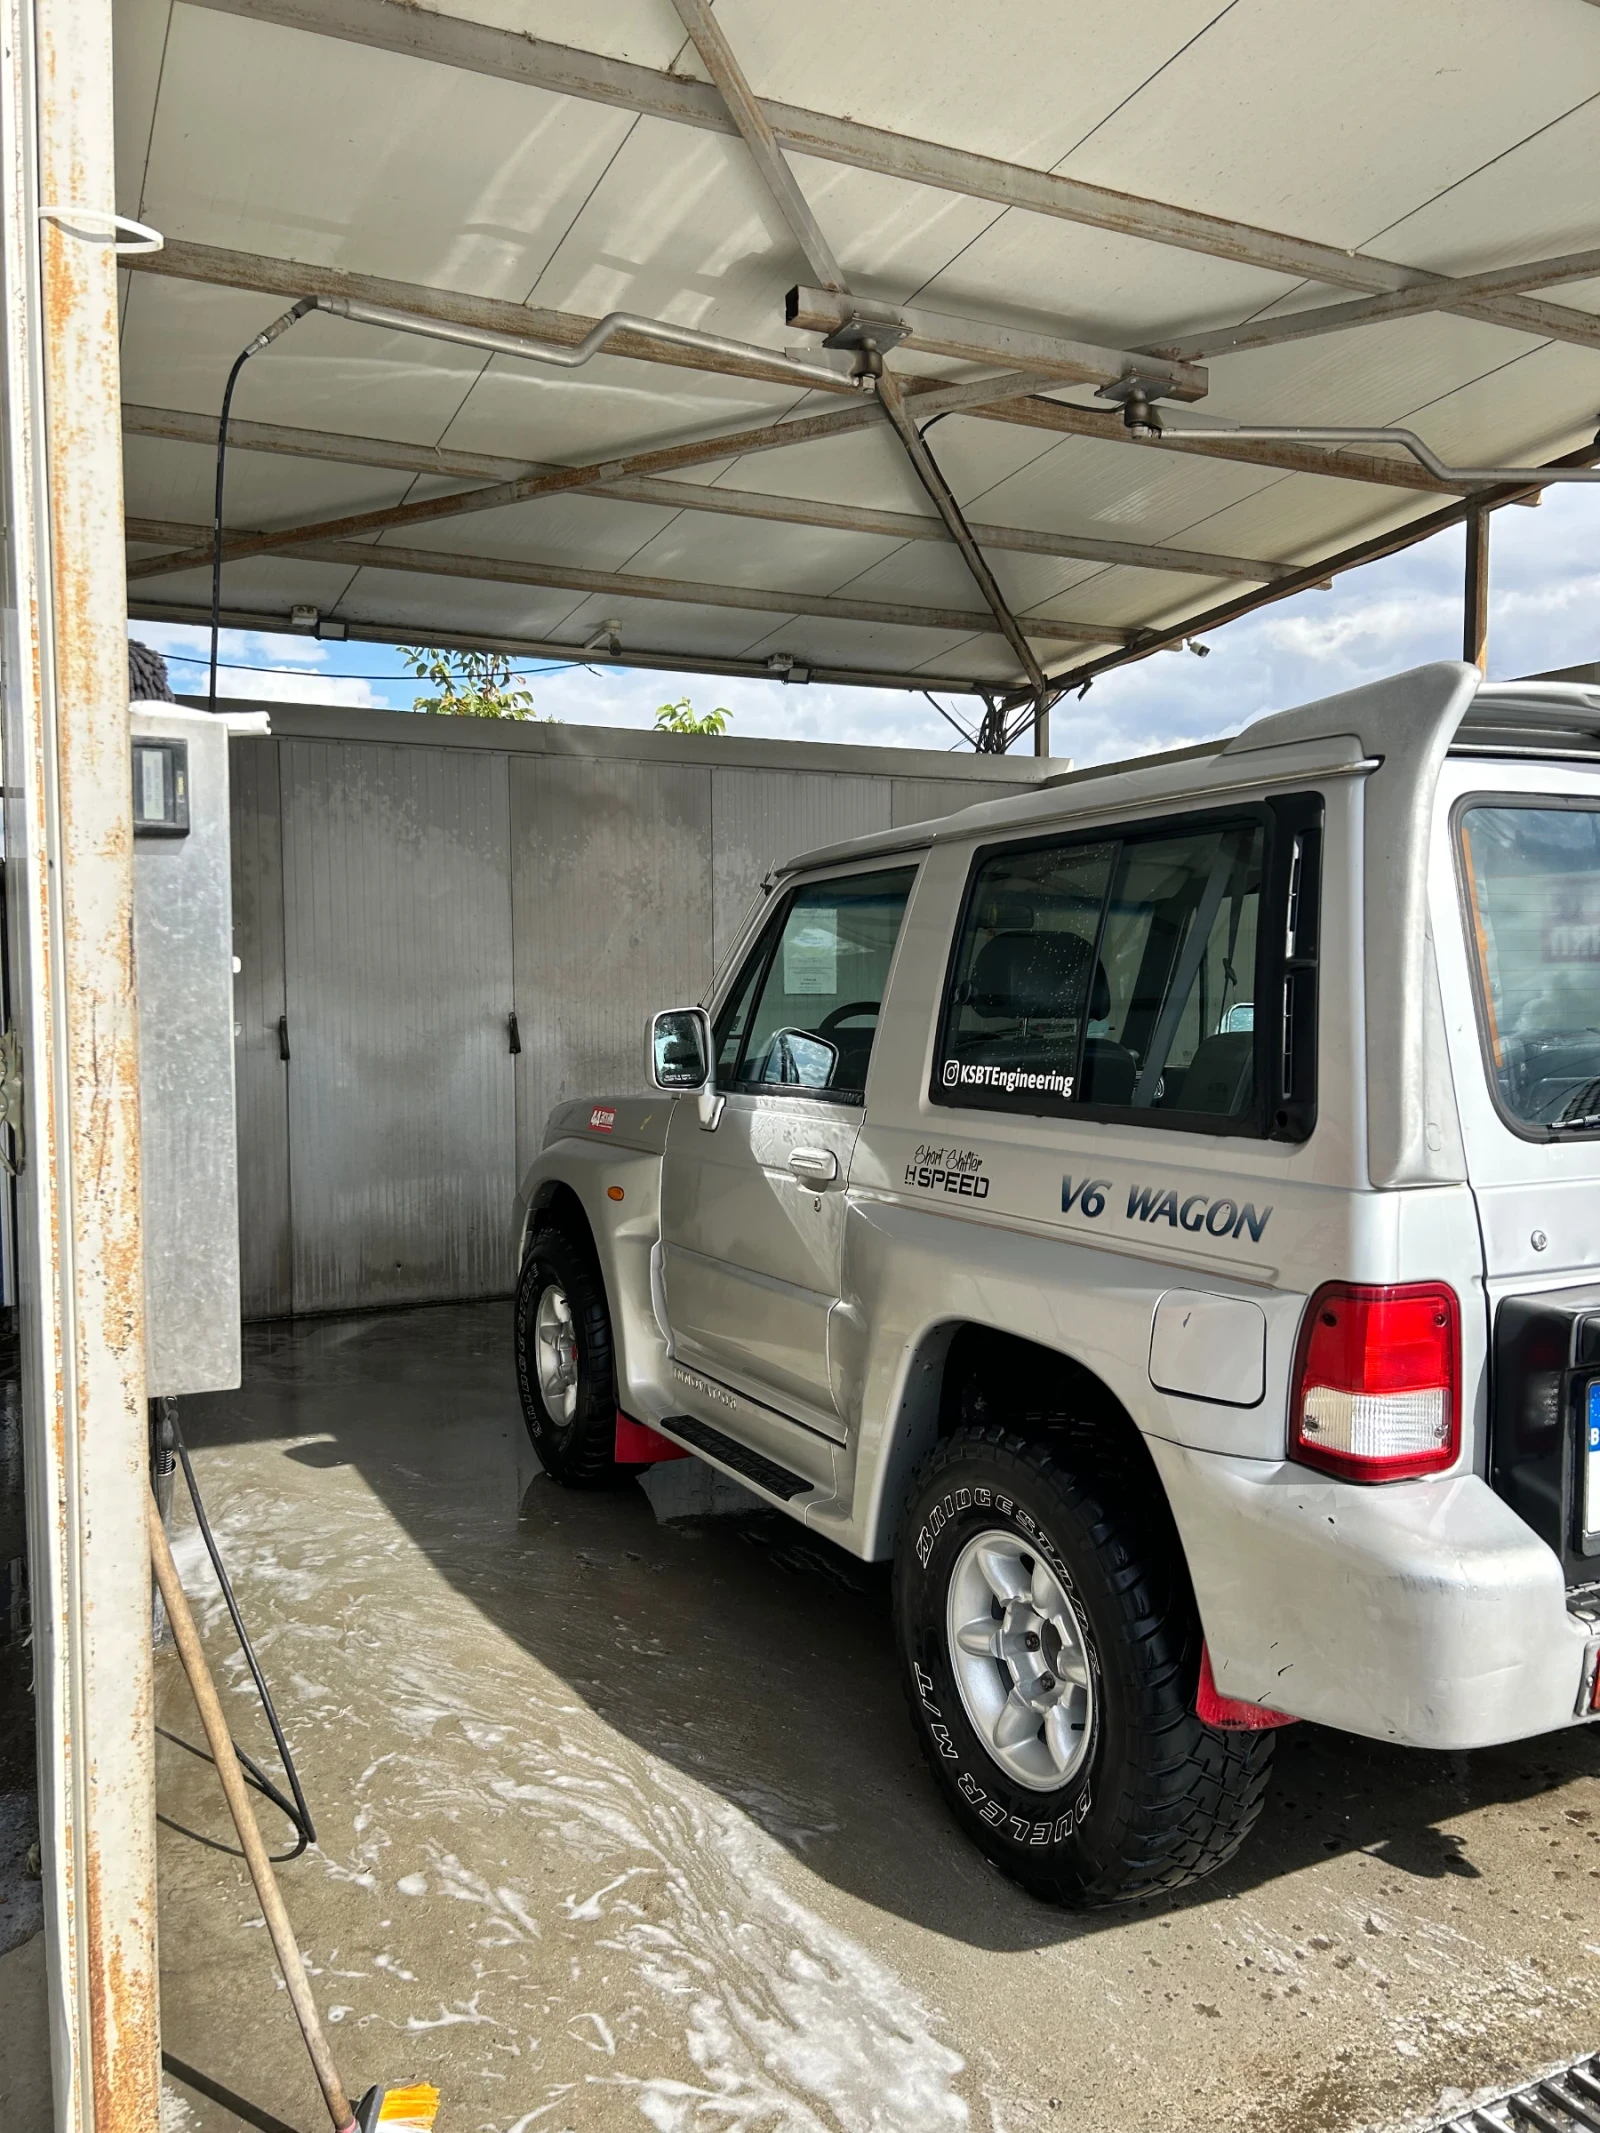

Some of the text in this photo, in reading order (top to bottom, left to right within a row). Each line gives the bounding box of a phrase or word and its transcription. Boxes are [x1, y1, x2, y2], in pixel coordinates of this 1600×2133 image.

[960, 1065, 1074, 1098] KSBTEngineering
[914, 1144, 983, 1172] Short Shifter
[1061, 1175, 1273, 1243] V6 WAGON
[916, 1487, 1101, 1676] BRIDGESTONE
[914, 1661, 1092, 1845] DUELER M/T
